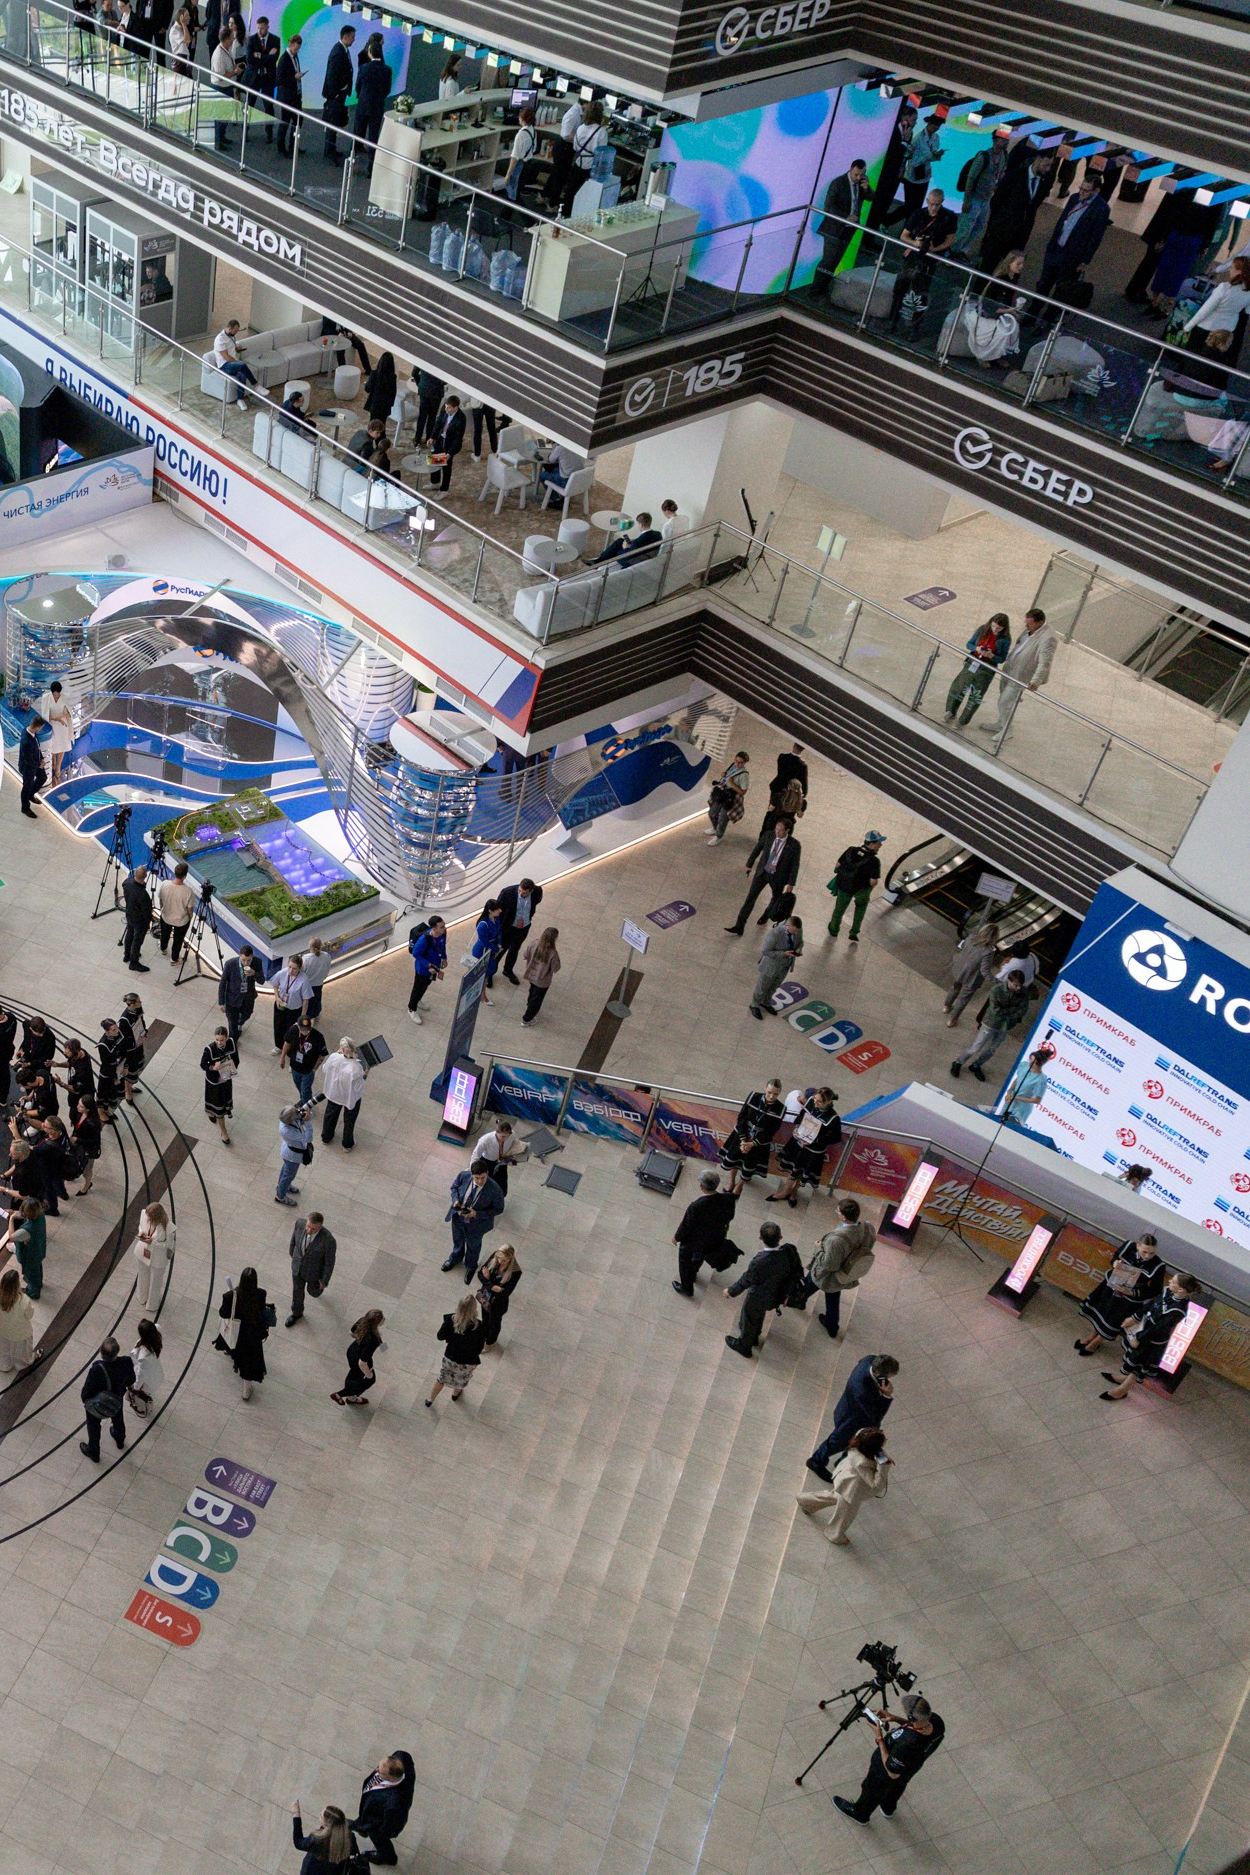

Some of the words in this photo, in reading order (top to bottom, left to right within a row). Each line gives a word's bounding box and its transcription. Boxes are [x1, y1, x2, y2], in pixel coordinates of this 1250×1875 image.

[755, 0, 831, 39] СБЕР
[0, 89, 39, 128] 185
[47, 117, 87, 151] лет.
[99, 141, 195, 212] Всегда
[203, 198, 301, 265] рядом
[682, 352, 746, 397] 185
[145, 424, 227, 505] РОССИЮ!
[1000, 452, 1095, 507] СБЕР
[3, 500, 43, 519] ЧИСТАЯ
[44, 486, 89, 509] ЭНЕРГИЯ
[788, 1009, 823, 1032] C
[809, 1026, 847, 1050] D
[1064, 1025, 1125, 1068] DALREFTRANS
[1083, 1008, 1137, 1047] ПРИМКРАБ
[1046, 1077, 1099, 1116] ALREFTRANS
[1059, 1057, 1110, 1095] ПРИМКРАБ
[1173, 1064, 1239, 1110] DALREFTRANS
[1035, 1103, 1086, 1141] ПРИМКРАБ
[1145, 1113, 1210, 1159] DALREFTRANS
[1166, 1096, 1222, 1137] ПРИМКРАБ
[1138, 1144, 1193, 1185] ПРИМКРАБ
[186, 1487, 234, 1526] B
[166, 1526, 212, 1563] C
[149, 1553, 198, 1595] D
[155, 1611, 173, 1627] S
